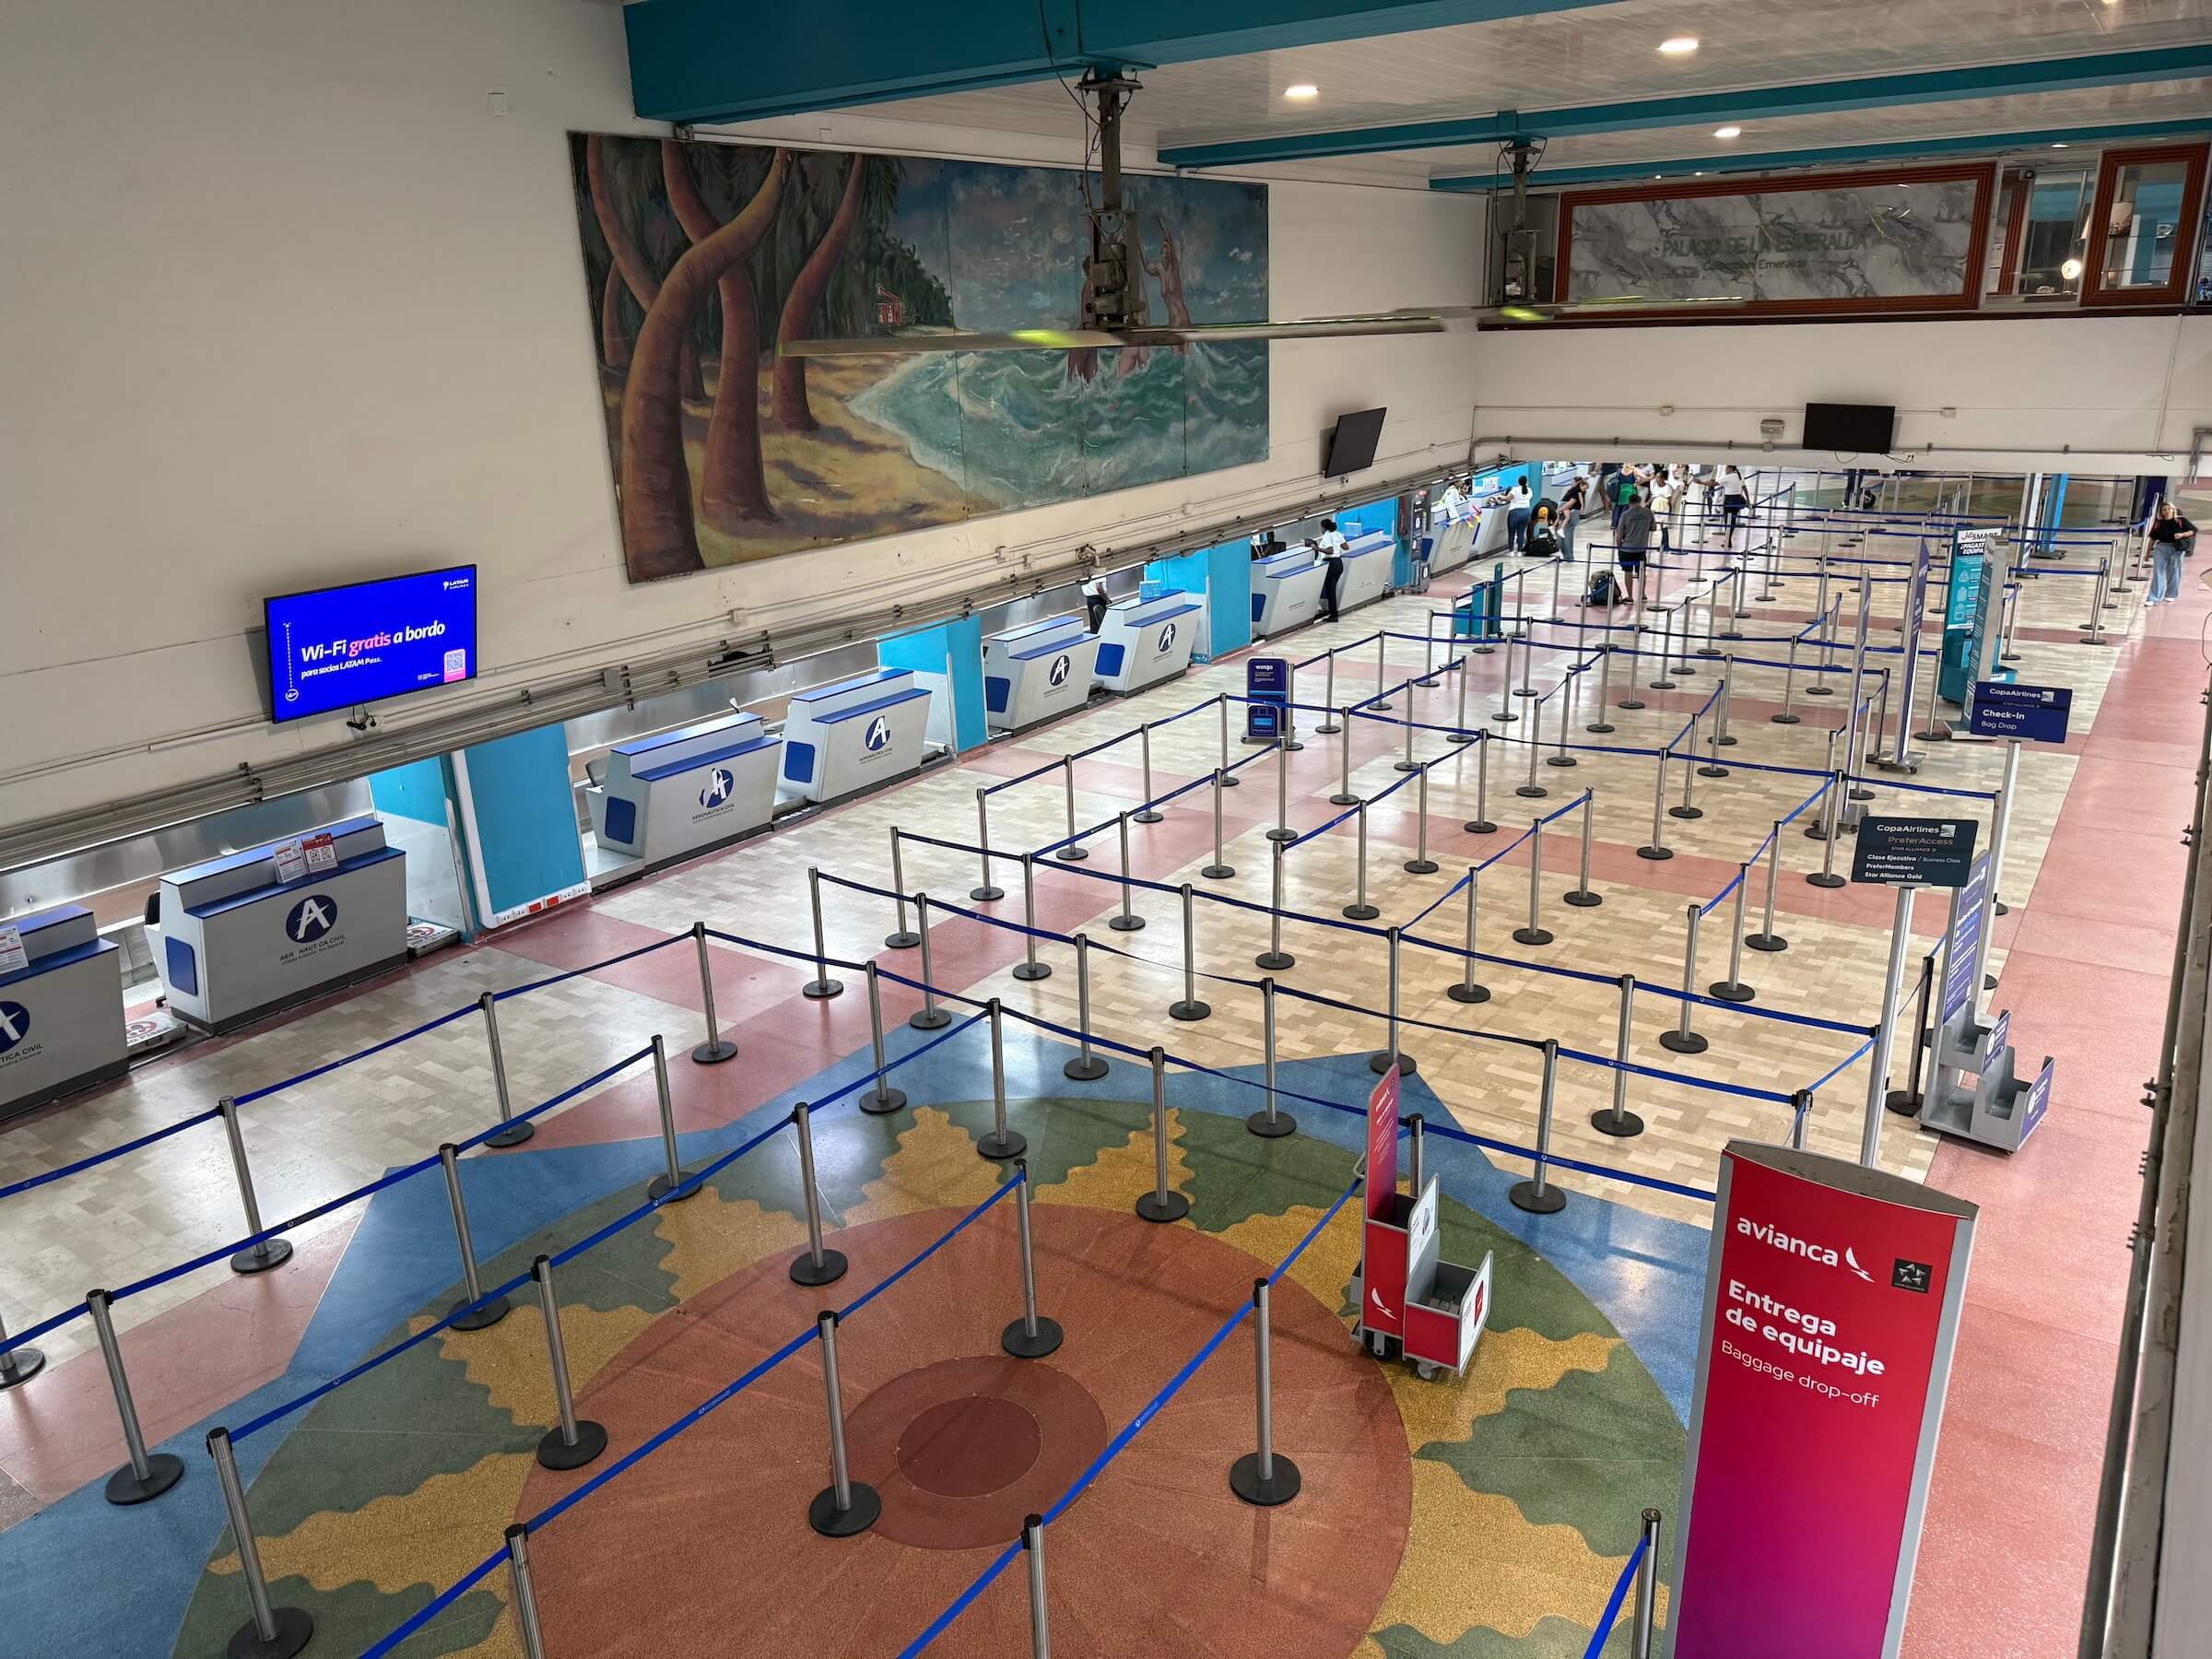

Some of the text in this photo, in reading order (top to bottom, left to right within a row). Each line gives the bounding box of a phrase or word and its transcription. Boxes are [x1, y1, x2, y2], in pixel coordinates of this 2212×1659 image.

[300, 620, 446, 663] Wi-Fi gratis a bordo
[300, 669, 319, 680] para
[319, 665, 339, 675] socios
[340, 658, 365, 670] LATAM
[1982, 721, 2017, 730] Bag Drop
[1877, 824, 1940, 833] CopaAirlines
[1888, 836, 1953, 845] PreferAccess
[22, 1043, 43, 1055] CIVIL
[1736, 1217, 1839, 1267] avianca
[1728, 1279, 1837, 1336] Entrega
[1725, 1308, 1886, 1375] de equipaje
[1722, 1340, 1880, 1408] Baggage drop-off
